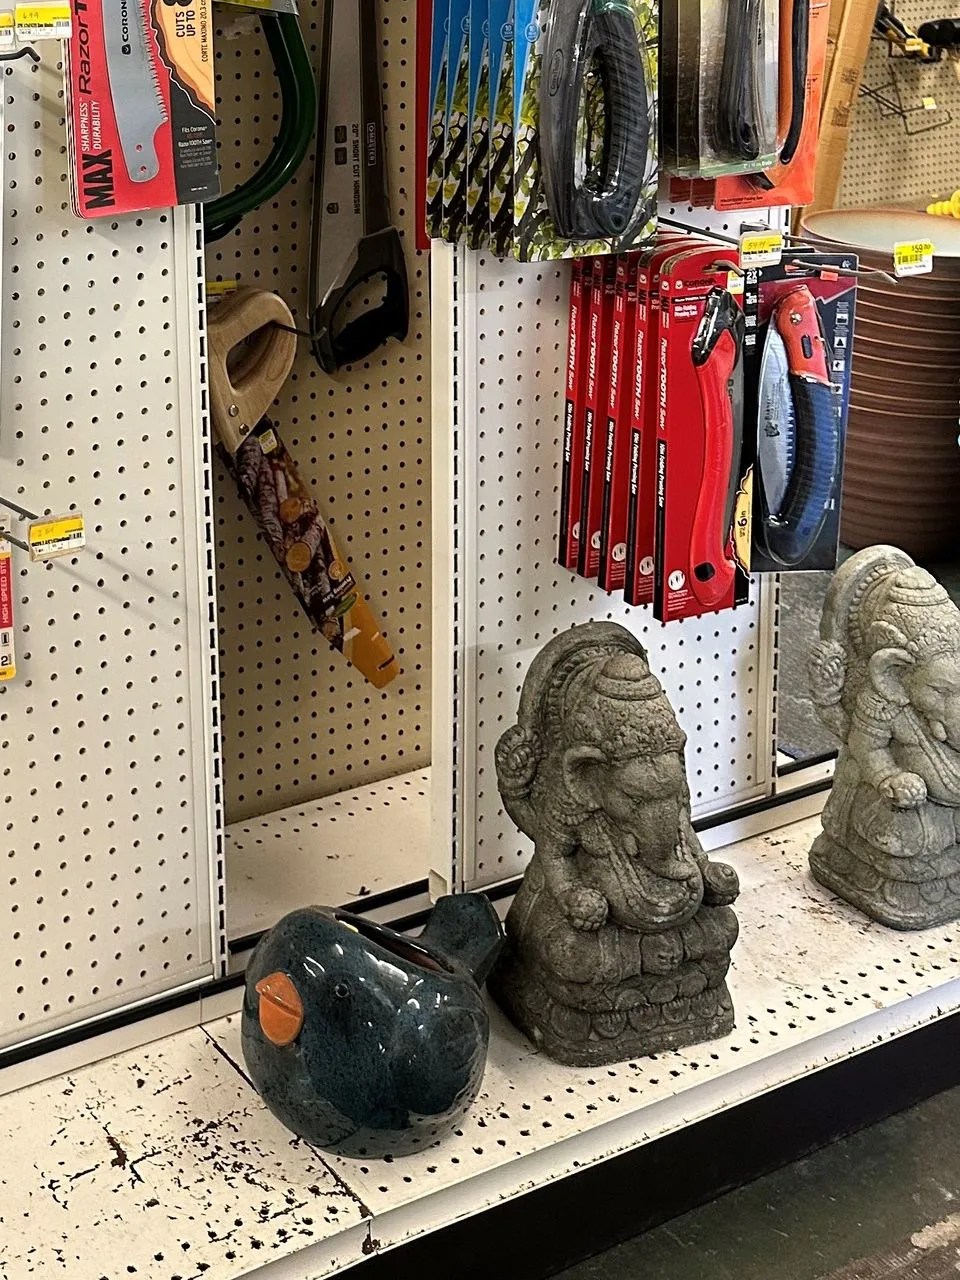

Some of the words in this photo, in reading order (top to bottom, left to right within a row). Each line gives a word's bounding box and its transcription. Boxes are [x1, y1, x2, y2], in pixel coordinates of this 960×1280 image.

[176, 11, 186, 38] CUTS
[186, 10, 196, 23] TO
[187, 23, 196, 37] UP
[80, 102, 91, 151] SHARPNESS
[93, 100, 102, 150] DURABILITY
[82, 148, 116, 210] MAX
[1, 575, 9, 603] SPEED
